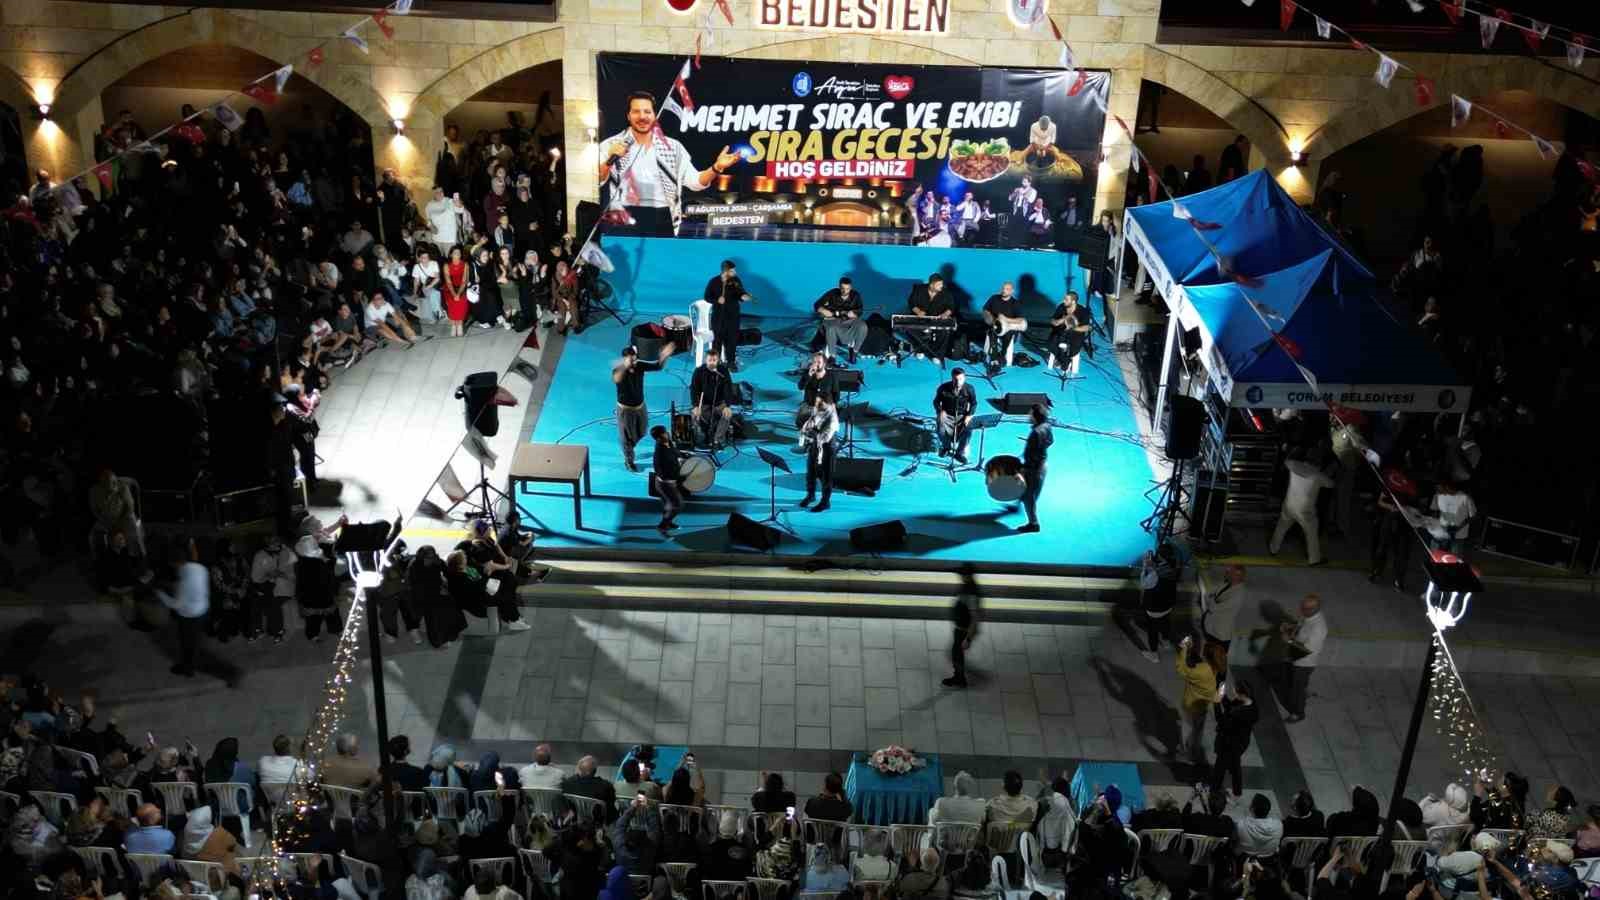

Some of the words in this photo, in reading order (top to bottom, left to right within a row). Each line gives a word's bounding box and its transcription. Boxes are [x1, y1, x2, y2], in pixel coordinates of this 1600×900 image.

[680, 103, 804, 132] MEHMET
[905, 102, 942, 129] VE
[948, 100, 1023, 129] EKİBİ
[747, 129, 823, 163] SIRA
[832, 128, 952, 161] GECESİ
[775, 161, 816, 179] HOŞ
[819, 160, 907, 177] GELDİNİZ
[712, 215, 765, 225] BEDESTEN
